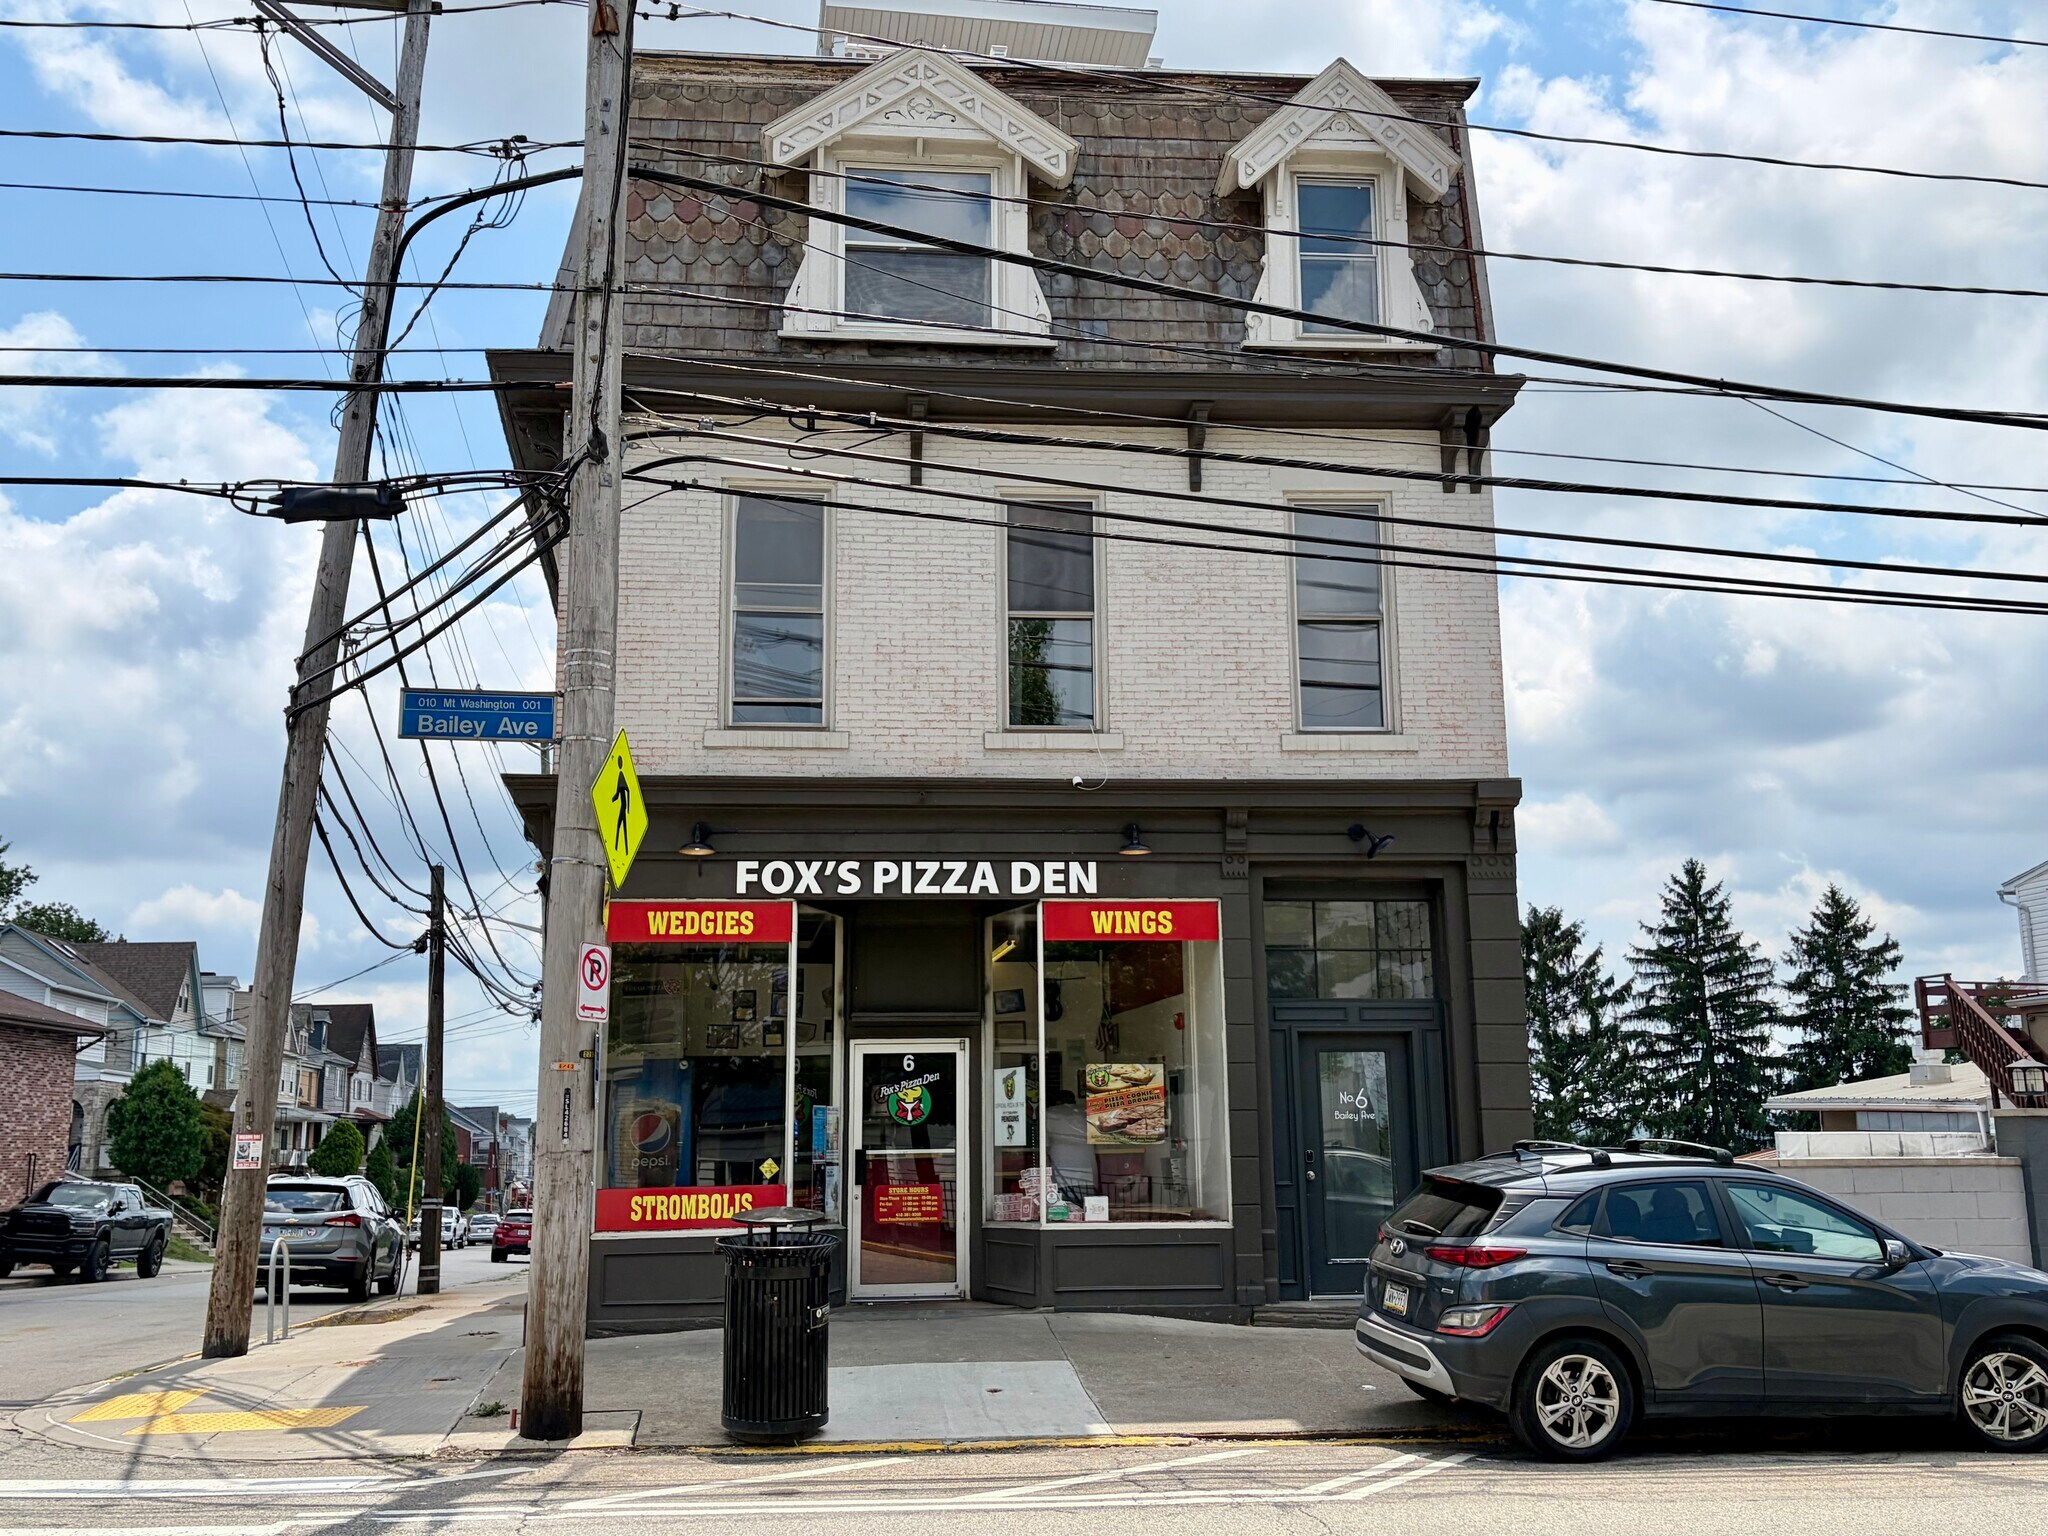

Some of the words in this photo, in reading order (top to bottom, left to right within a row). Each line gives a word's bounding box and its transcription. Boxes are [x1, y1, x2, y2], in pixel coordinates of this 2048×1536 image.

[418, 698, 437, 708] 010
[443, 698, 456, 708] Mt
[460, 699, 515, 711] Washington
[522, 700, 541, 710] 001
[418, 714, 486, 737] Bailey
[497, 717, 539, 735] Ave
[736, 860, 862, 895] FOX'S
[873, 861, 1000, 895] PIZZA
[1010, 861, 1098, 894] DEN
[647, 910, 754, 935] WEDGIES
[1091, 910, 1173, 935] WINGS
[903, 1054, 915, 1072] 6
[880, 1084, 900, 1097] Fox's
[900, 1077, 923, 1092] Pizza
[923, 1073, 940, 1085] Den
[1104, 1096, 1125, 1104] PIZZA
[1126, 1090, 1153, 1099] COOKIE
[1105, 1101, 1126, 1109] PIZZA
[1127, 1095, 1161, 1105] BROWNIE
[1355, 1088, 1368, 1109] 6
[1334, 1110, 1358, 1122] Bailey
[1360, 1110, 1376, 1120] Ave
[631, 1154, 669, 1169] pepsi
[630, 1192, 754, 1222] STROMBOLIS
